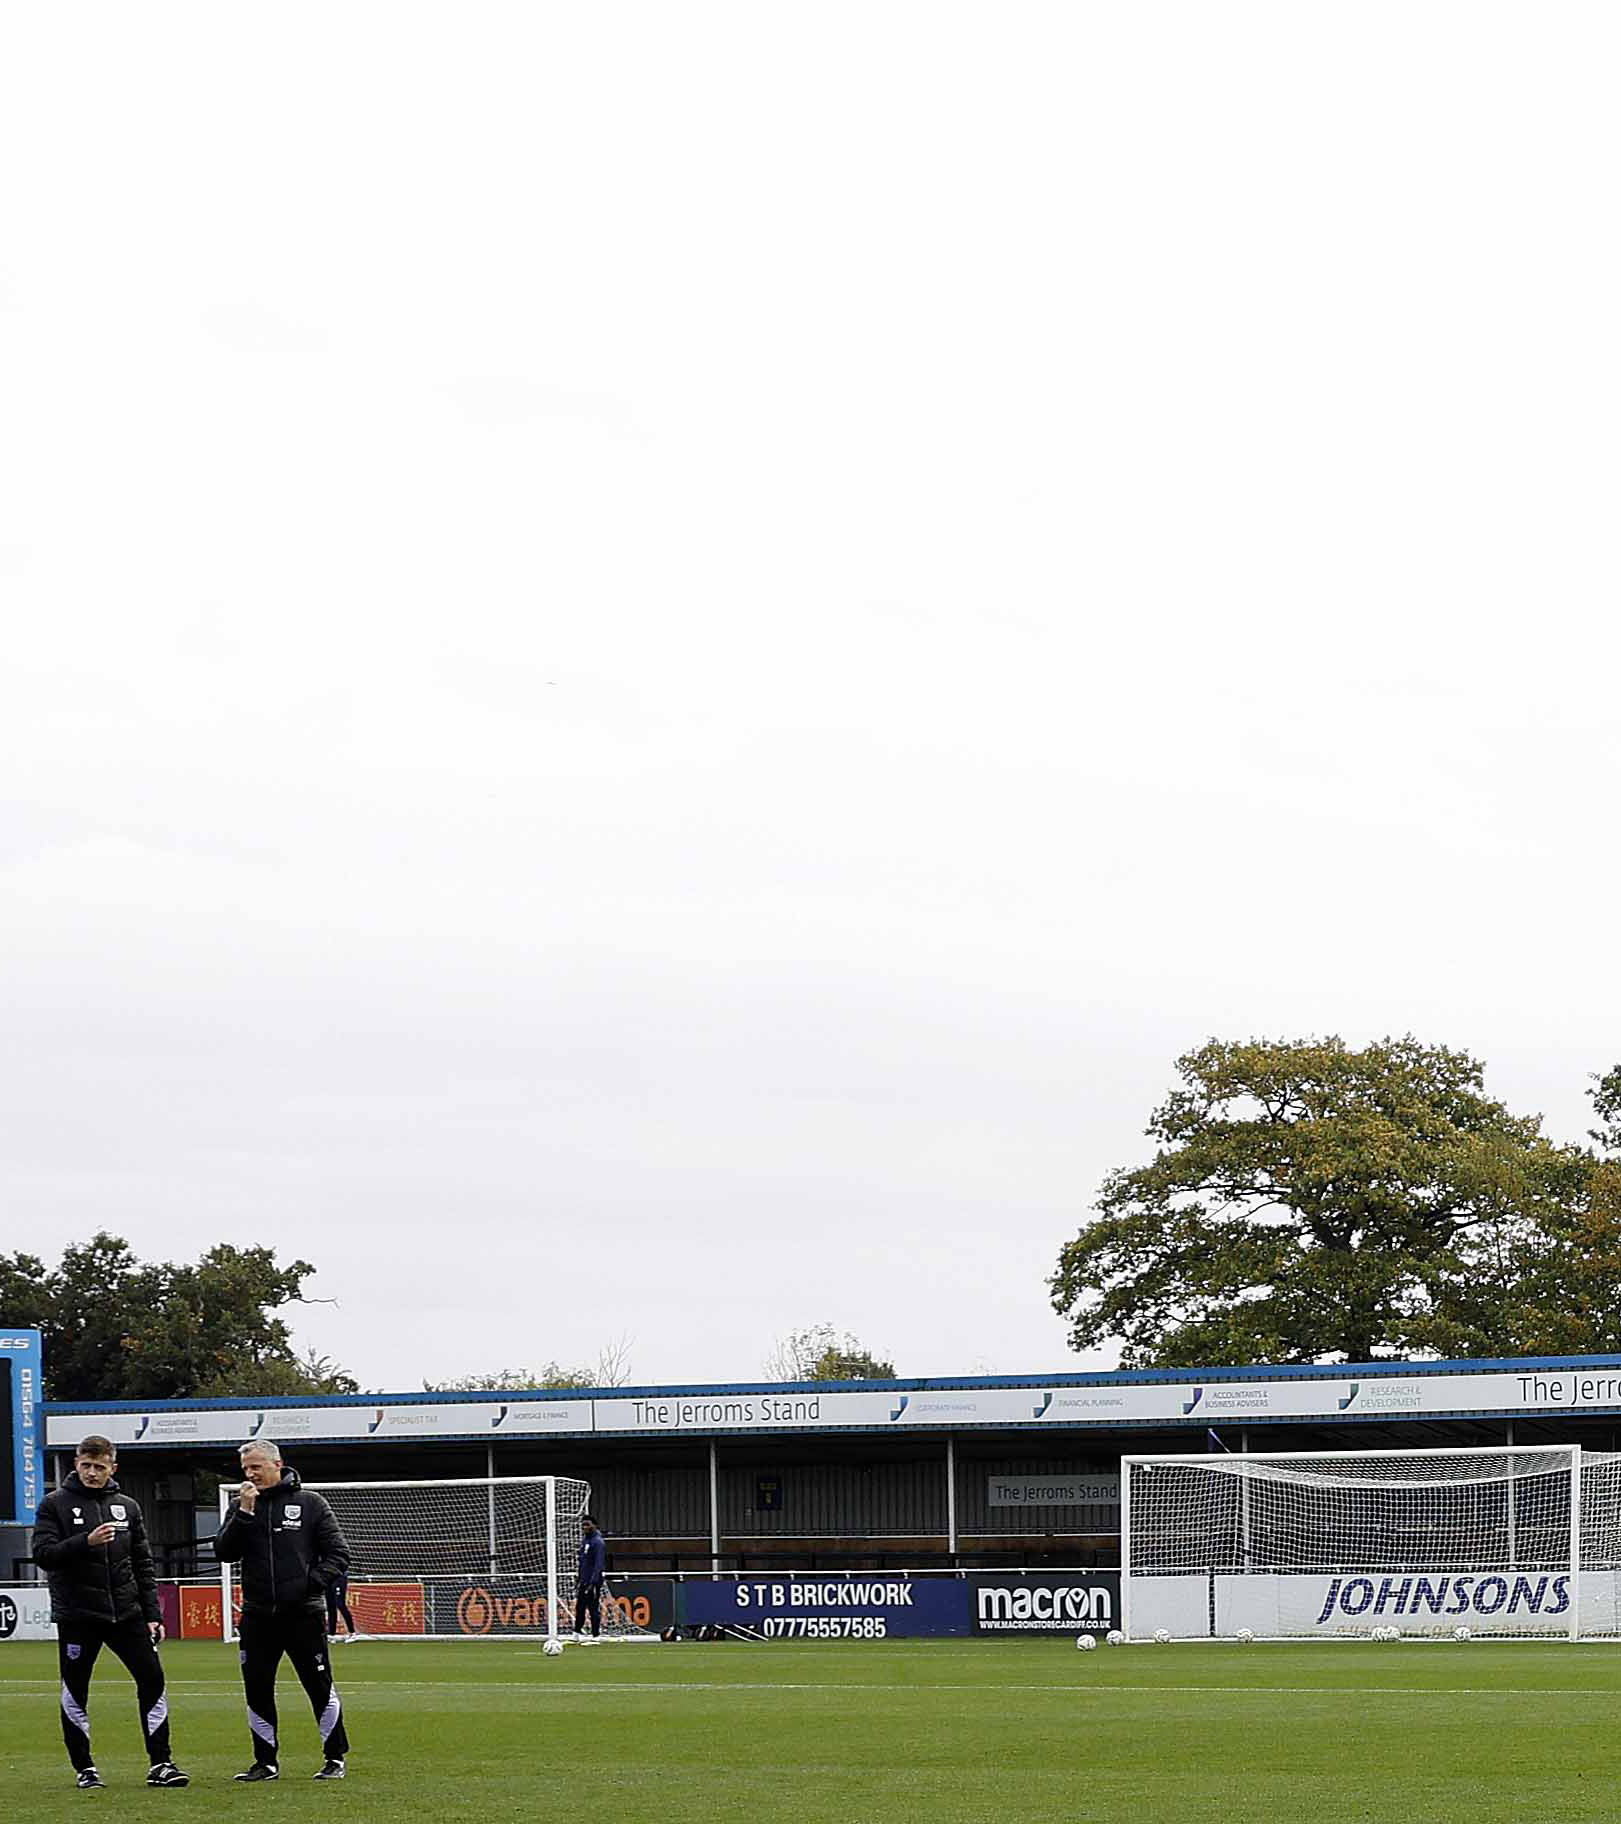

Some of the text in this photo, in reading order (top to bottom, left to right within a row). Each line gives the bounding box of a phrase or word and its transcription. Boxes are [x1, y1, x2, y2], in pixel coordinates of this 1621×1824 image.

[1517, 1376, 1564, 1402] The
[632, 1396, 820, 1427] The Jerroms Stand
[997, 1483, 1117, 1502] The Jerroms Stand
[736, 1583, 913, 1606] S T B BRICKWORK
[978, 1587, 1111, 1619] macron
[1316, 1575, 1571, 1624] JOHNSONS
[763, 1617, 886, 1638] 07775557585
